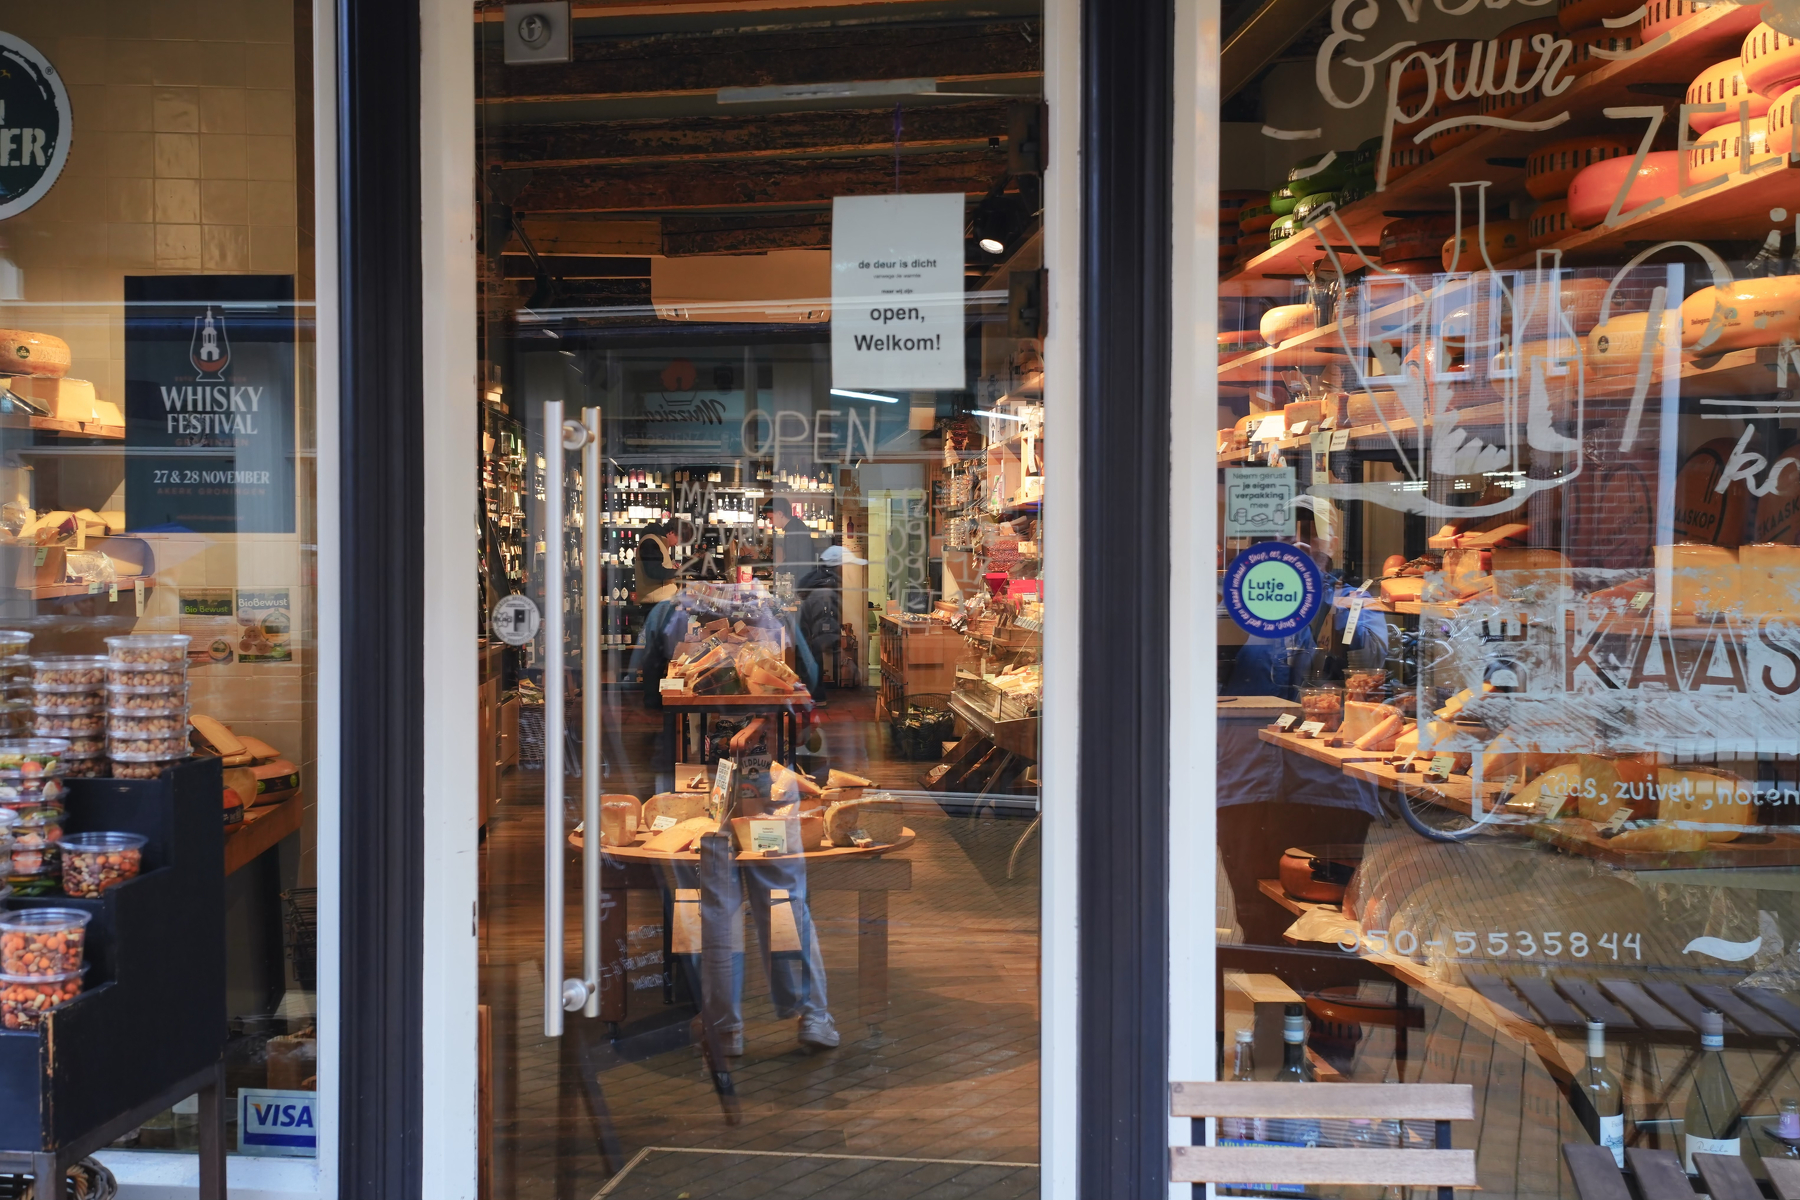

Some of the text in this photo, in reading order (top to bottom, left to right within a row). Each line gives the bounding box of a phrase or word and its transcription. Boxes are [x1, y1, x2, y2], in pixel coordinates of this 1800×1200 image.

[1375, 33, 1576, 192] puur
[1602, 100, 1800, 229] ZEL
[858, 259, 937, 269] de deur is dicht
[870, 307, 925, 325] open,
[854, 334, 941, 351] Welkom!
[160, 386, 264, 412] WHISKY
[167, 413, 258, 434] FESTIVAL
[175, 438, 249, 446] GRONINGEN
[740, 406, 876, 472] OPEN
[153, 470, 270, 484] 27 & 28 NOVEMBER
[1259, 472, 1287, 481] gerust
[198, 487, 266, 495] GRONINGEN
[1242, 482, 1276, 491] je eigen
[678, 481, 719, 516] MA
[1235, 492, 1284, 501] verpakking
[674, 551, 722, 577] ZA
[1248, 578, 1284, 593] Lutje
[1248, 590, 1297, 602] Lokaal
[184, 605, 229, 613] Bio Bewust
[740, 757, 772, 770] ILDPLUK
[250, 1103, 314, 1128] VISA
